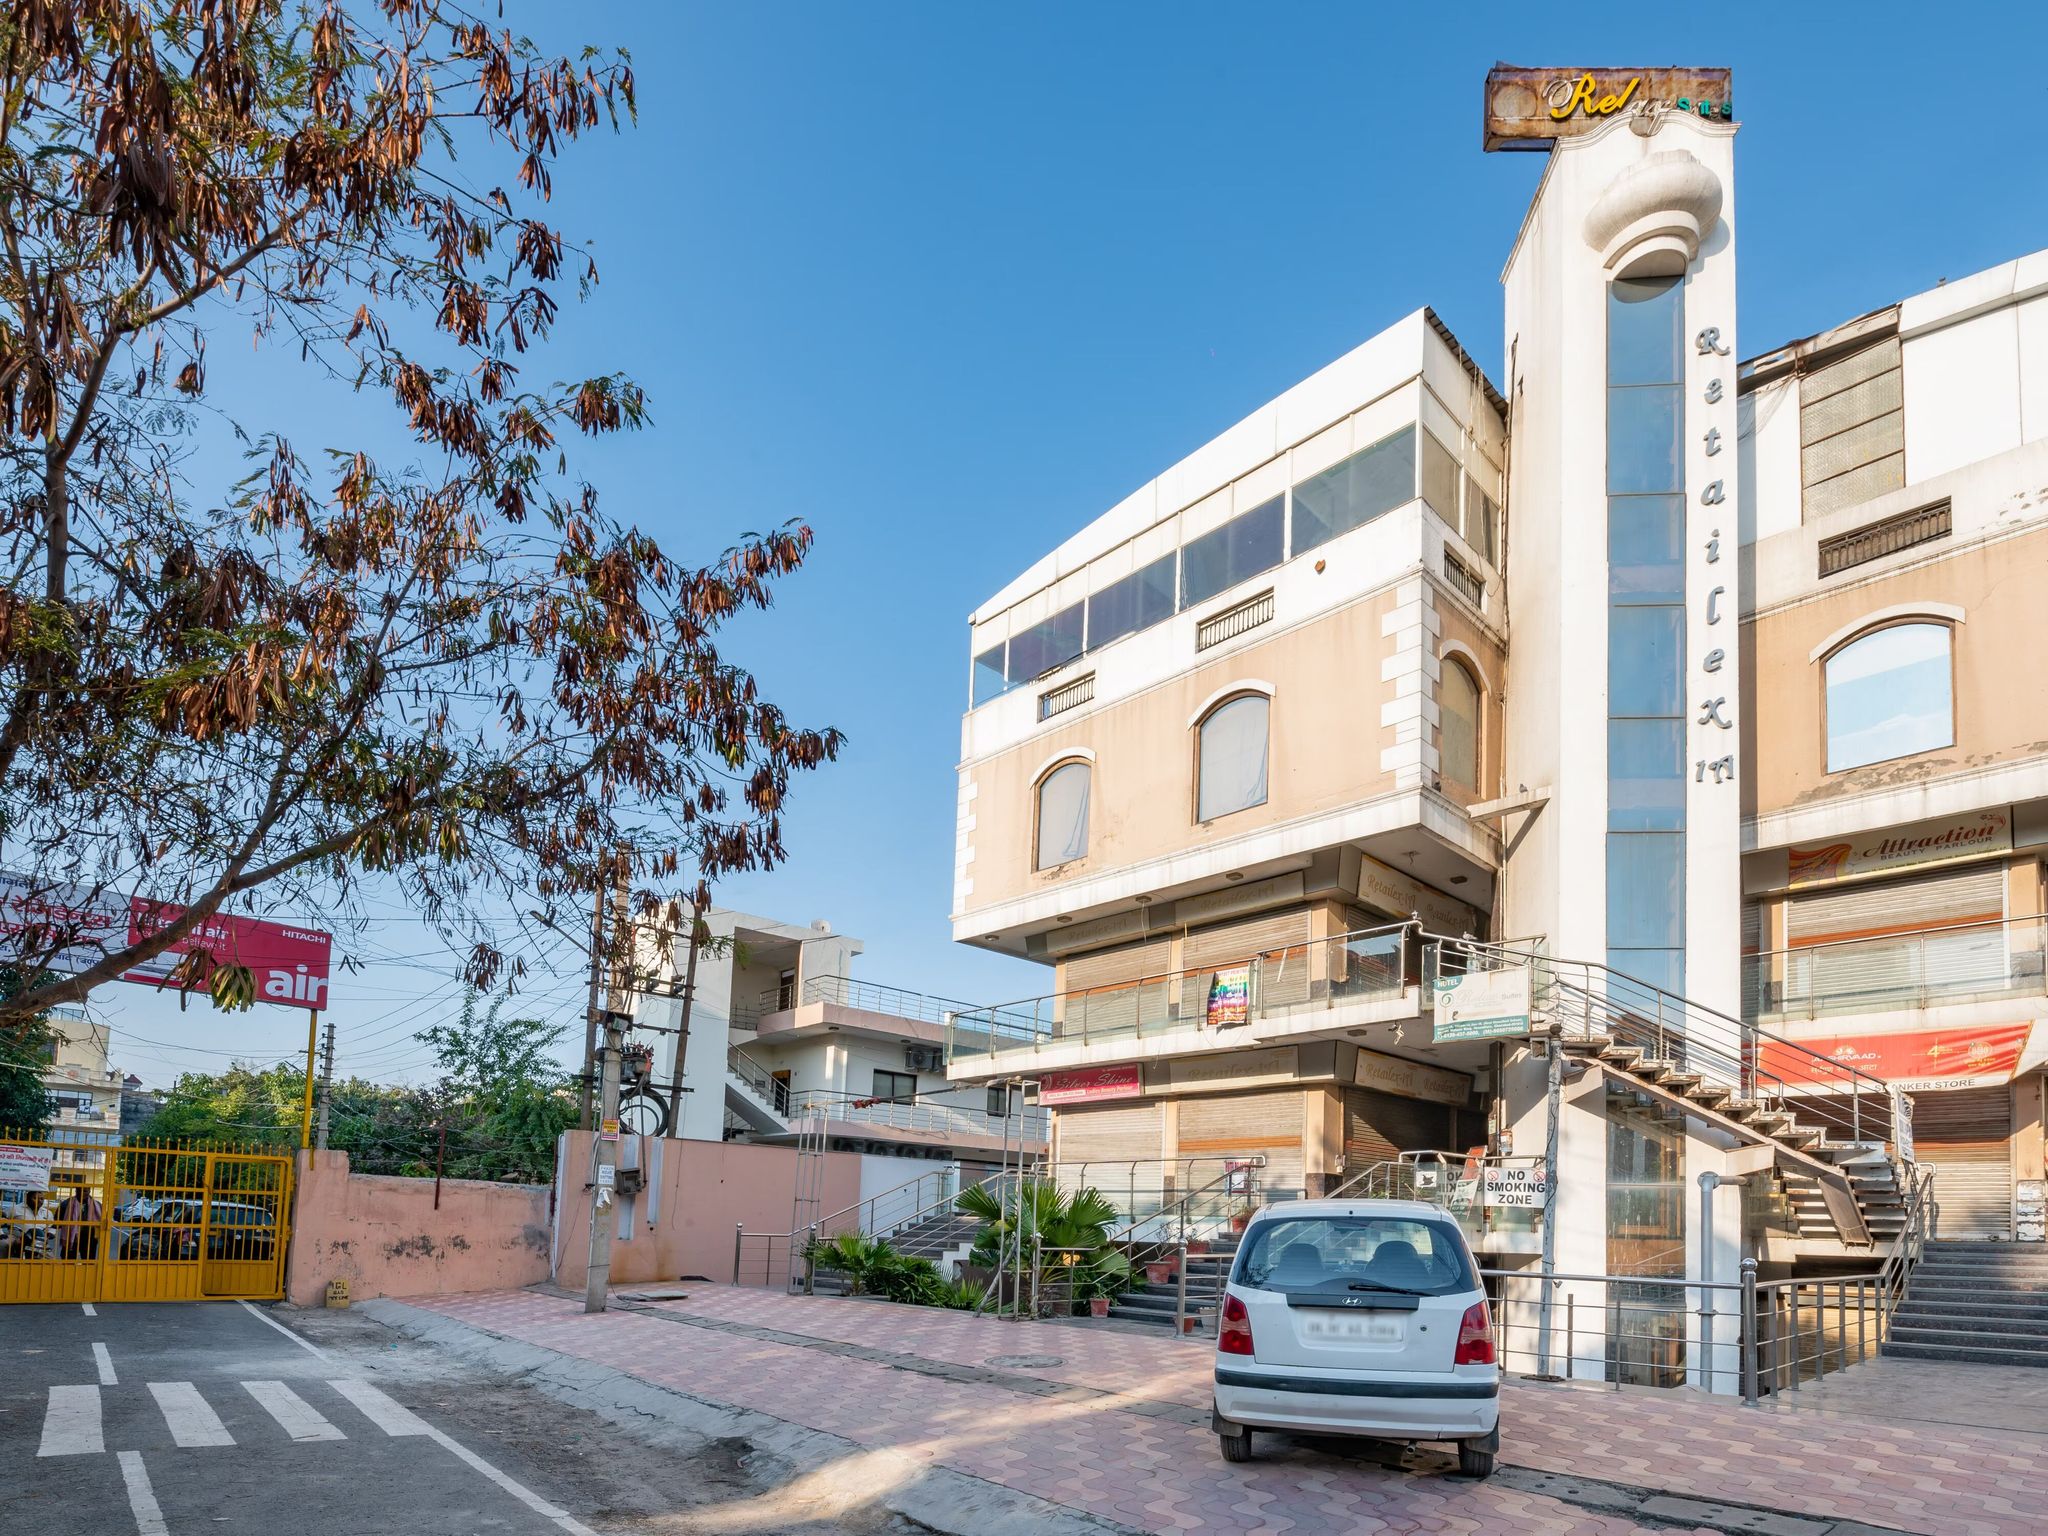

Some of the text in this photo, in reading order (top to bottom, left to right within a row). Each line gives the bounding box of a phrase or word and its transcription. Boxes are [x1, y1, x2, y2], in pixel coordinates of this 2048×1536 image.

[1862, 824, 1995, 857] Attraction
[1880, 847, 1926, 861] BEAUTY
[1936, 836, 1993, 851] PARLOUR
[282, 929, 326, 944] HITACHI
[265, 964, 328, 1002] air
[1094, 1073, 1133, 1087] Shine
[1935, 1079, 1976, 1089] STORE
[1507, 1170, 1525, 1180] NO
[1487, 1182, 1545, 1193] SMOKING
[1498, 1194, 1532, 1205] ZONE
